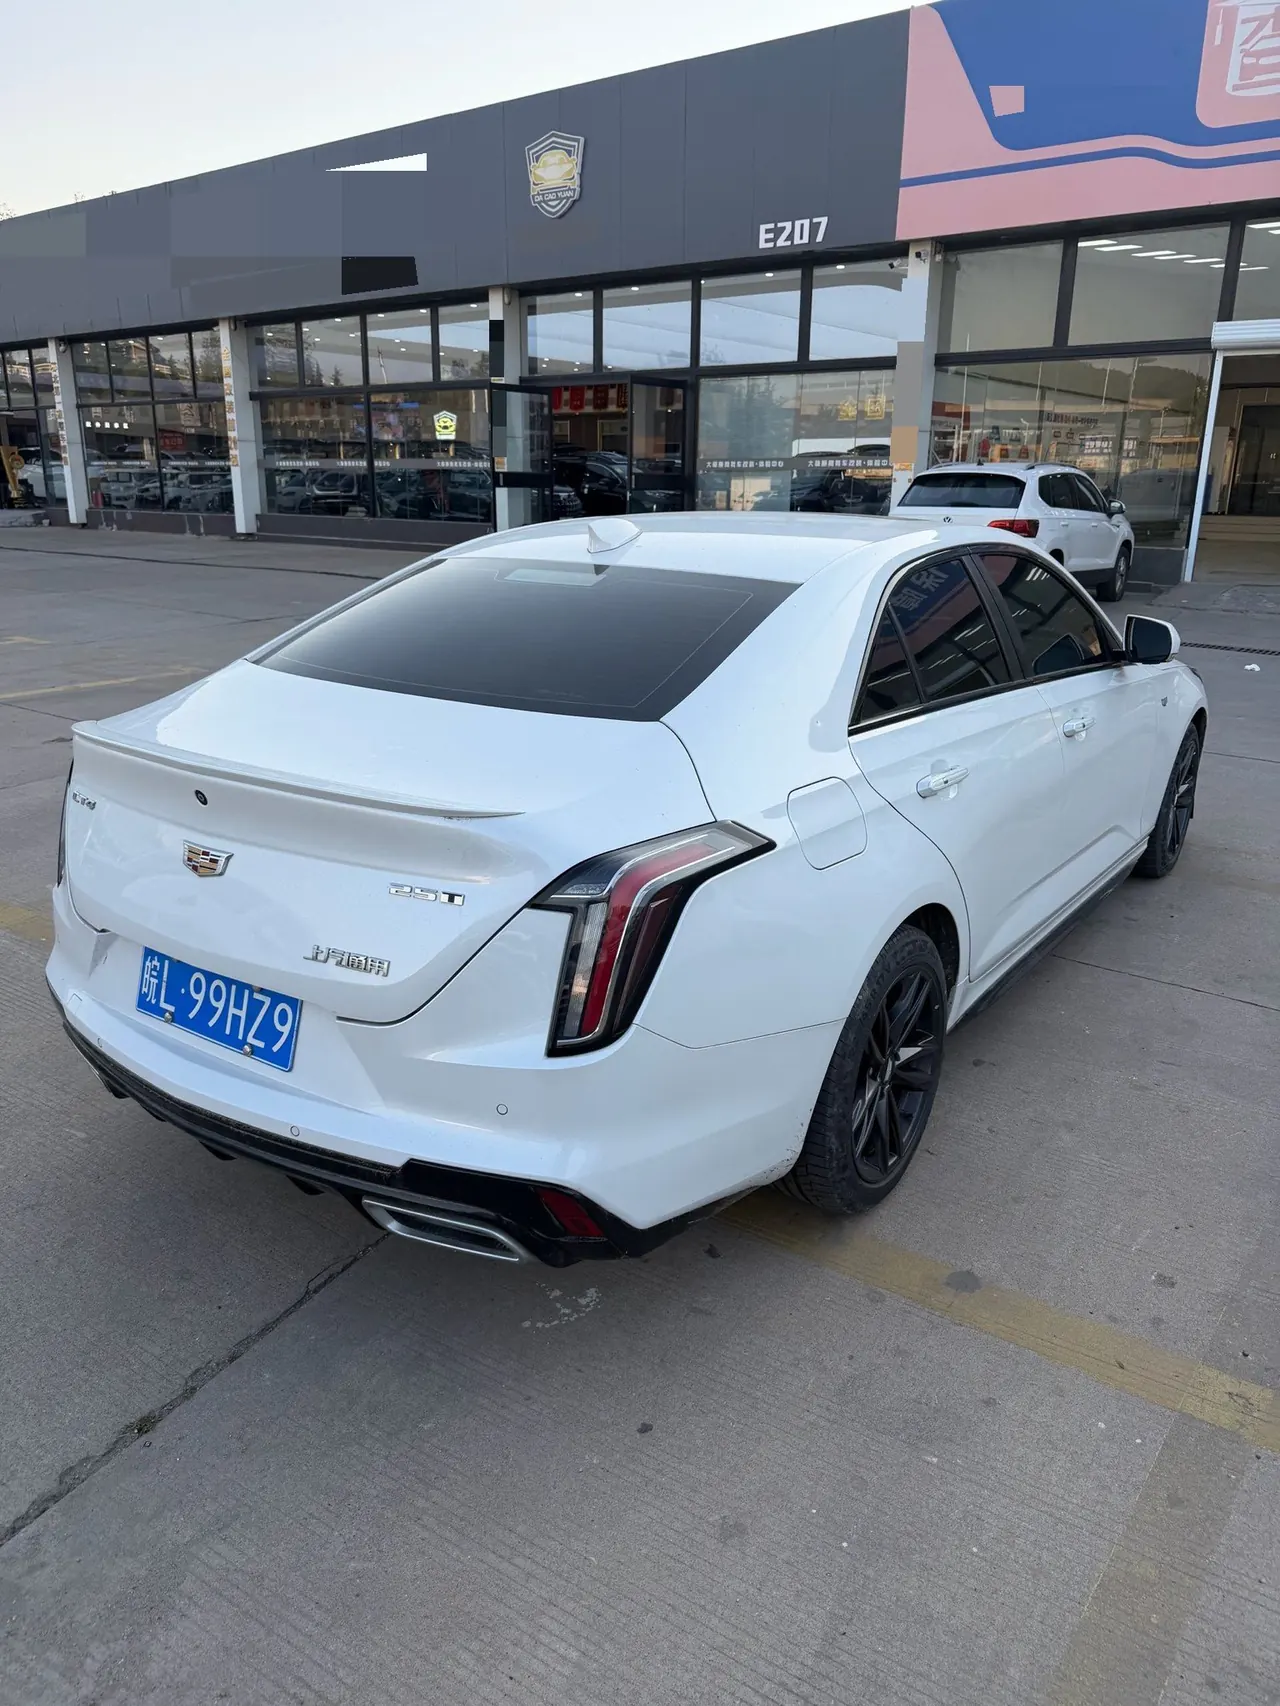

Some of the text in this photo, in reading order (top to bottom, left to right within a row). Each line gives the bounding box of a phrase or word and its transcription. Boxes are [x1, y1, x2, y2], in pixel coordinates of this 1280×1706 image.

[557, 190, 574, 199] YUAN
[758, 216, 828, 249] E207
[388, 882, 465, 907] 25T
[303, 944, 391, 977] 上汽通用
